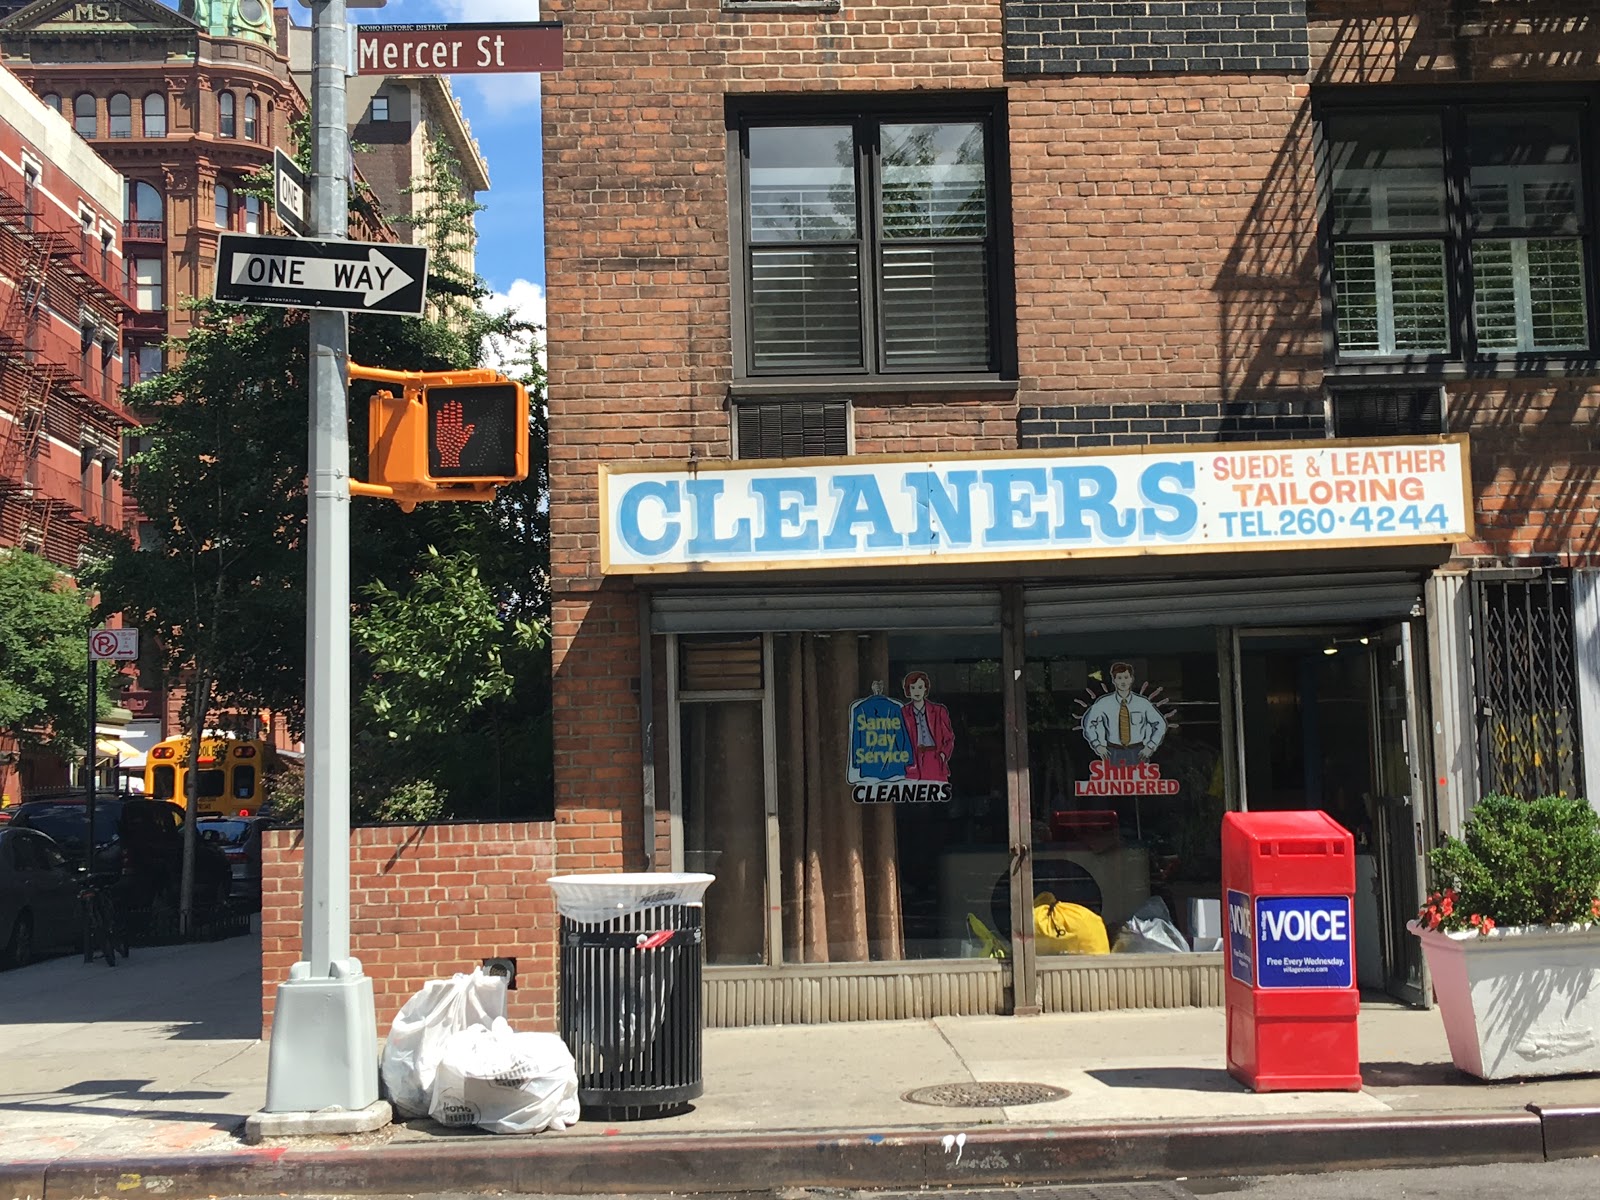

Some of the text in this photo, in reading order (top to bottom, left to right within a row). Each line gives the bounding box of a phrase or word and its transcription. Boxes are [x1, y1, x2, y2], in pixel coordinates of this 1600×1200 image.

[415, 23, 448, 31] DISTRICT
[359, 34, 505, 69] Mercer St
[282, 176, 299, 212] ONE
[248, 257, 394, 291] ONE WAY
[1212, 449, 1447, 482] SUEDE & LEATHER
[1231, 476, 1426, 508] TAILORING
[615, 460, 1198, 559] CLEANERS
[856, 714, 901, 731] Same
[865, 731, 897, 751] Day
[855, 748, 910, 764] Service
[1090, 759, 1161, 780] Shirts
[852, 783, 953, 804] CLEANERS
[1076, 781, 1180, 795] LAUNDERED
[1266, 910, 1347, 941] VOICE
[1266, 957, 1345, 967] Free Every Wednesday.
[1282, 966, 1328, 974] villagevoice.com
